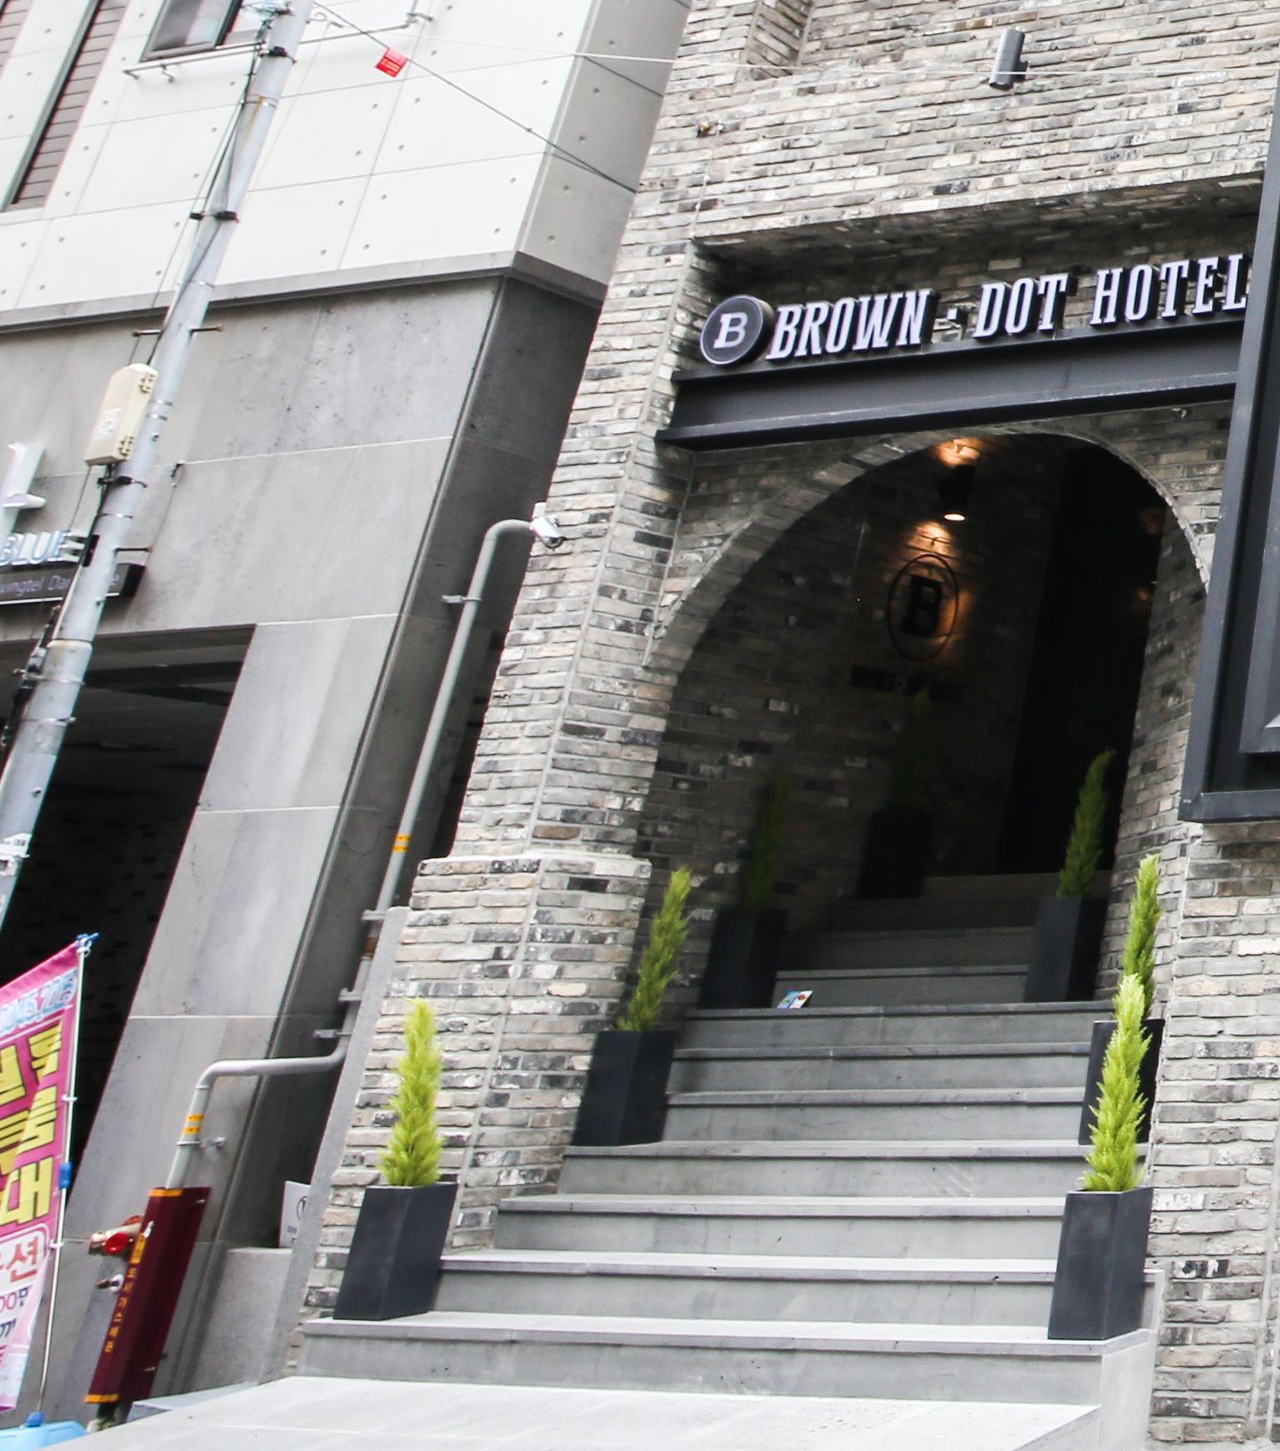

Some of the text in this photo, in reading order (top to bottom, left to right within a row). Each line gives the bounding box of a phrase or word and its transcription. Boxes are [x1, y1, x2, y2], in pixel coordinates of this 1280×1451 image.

[713, 311, 748, 348] B
[765, 288, 935, 361] BROWN
[972, 273, 1072, 340] DOT
[1090, 254, 1247, 327] HOTEL
